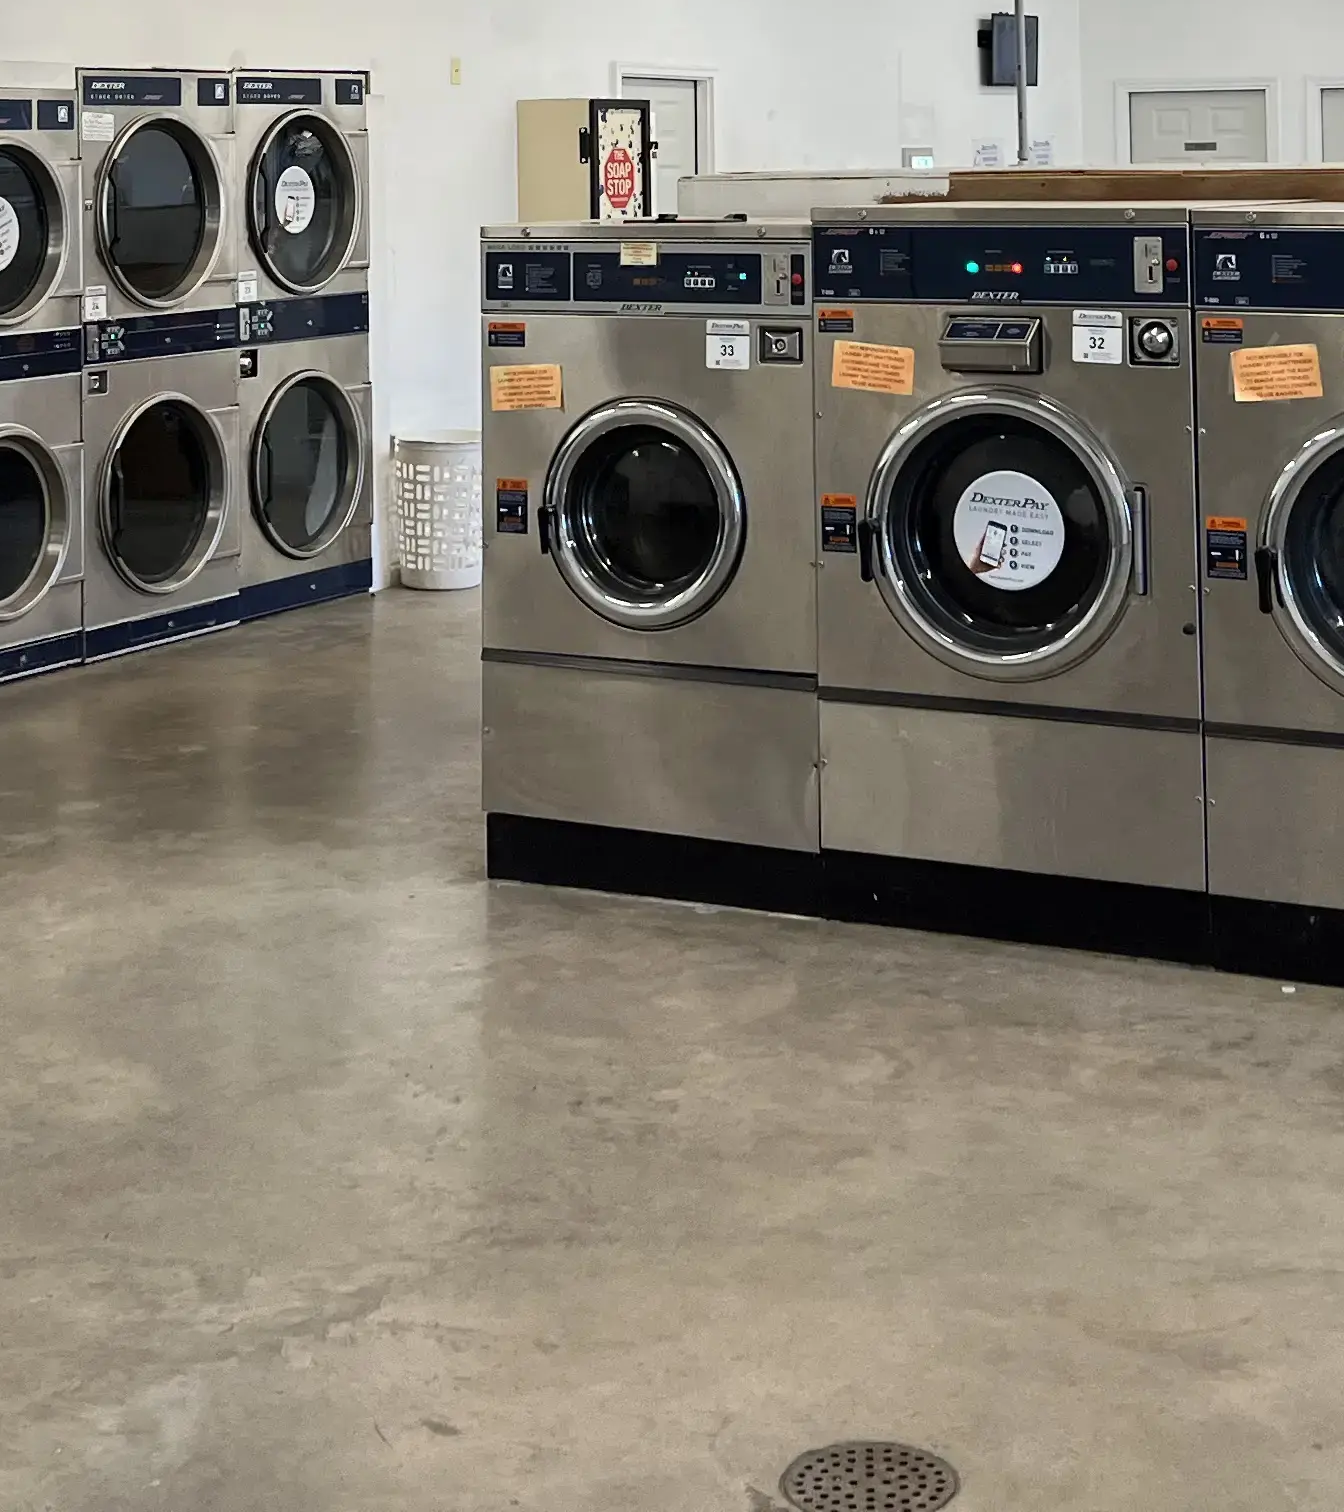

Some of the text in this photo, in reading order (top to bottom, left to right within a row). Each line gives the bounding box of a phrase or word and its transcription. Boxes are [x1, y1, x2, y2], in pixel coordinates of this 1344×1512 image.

[613, 150, 624, 160] THE
[607, 162, 631, 179] SOAP
[607, 179, 631, 196] STOP
[971, 291, 1020, 300] DEXTER
[1089, 337, 1105, 349] 32
[721, 345, 734, 356] 33
